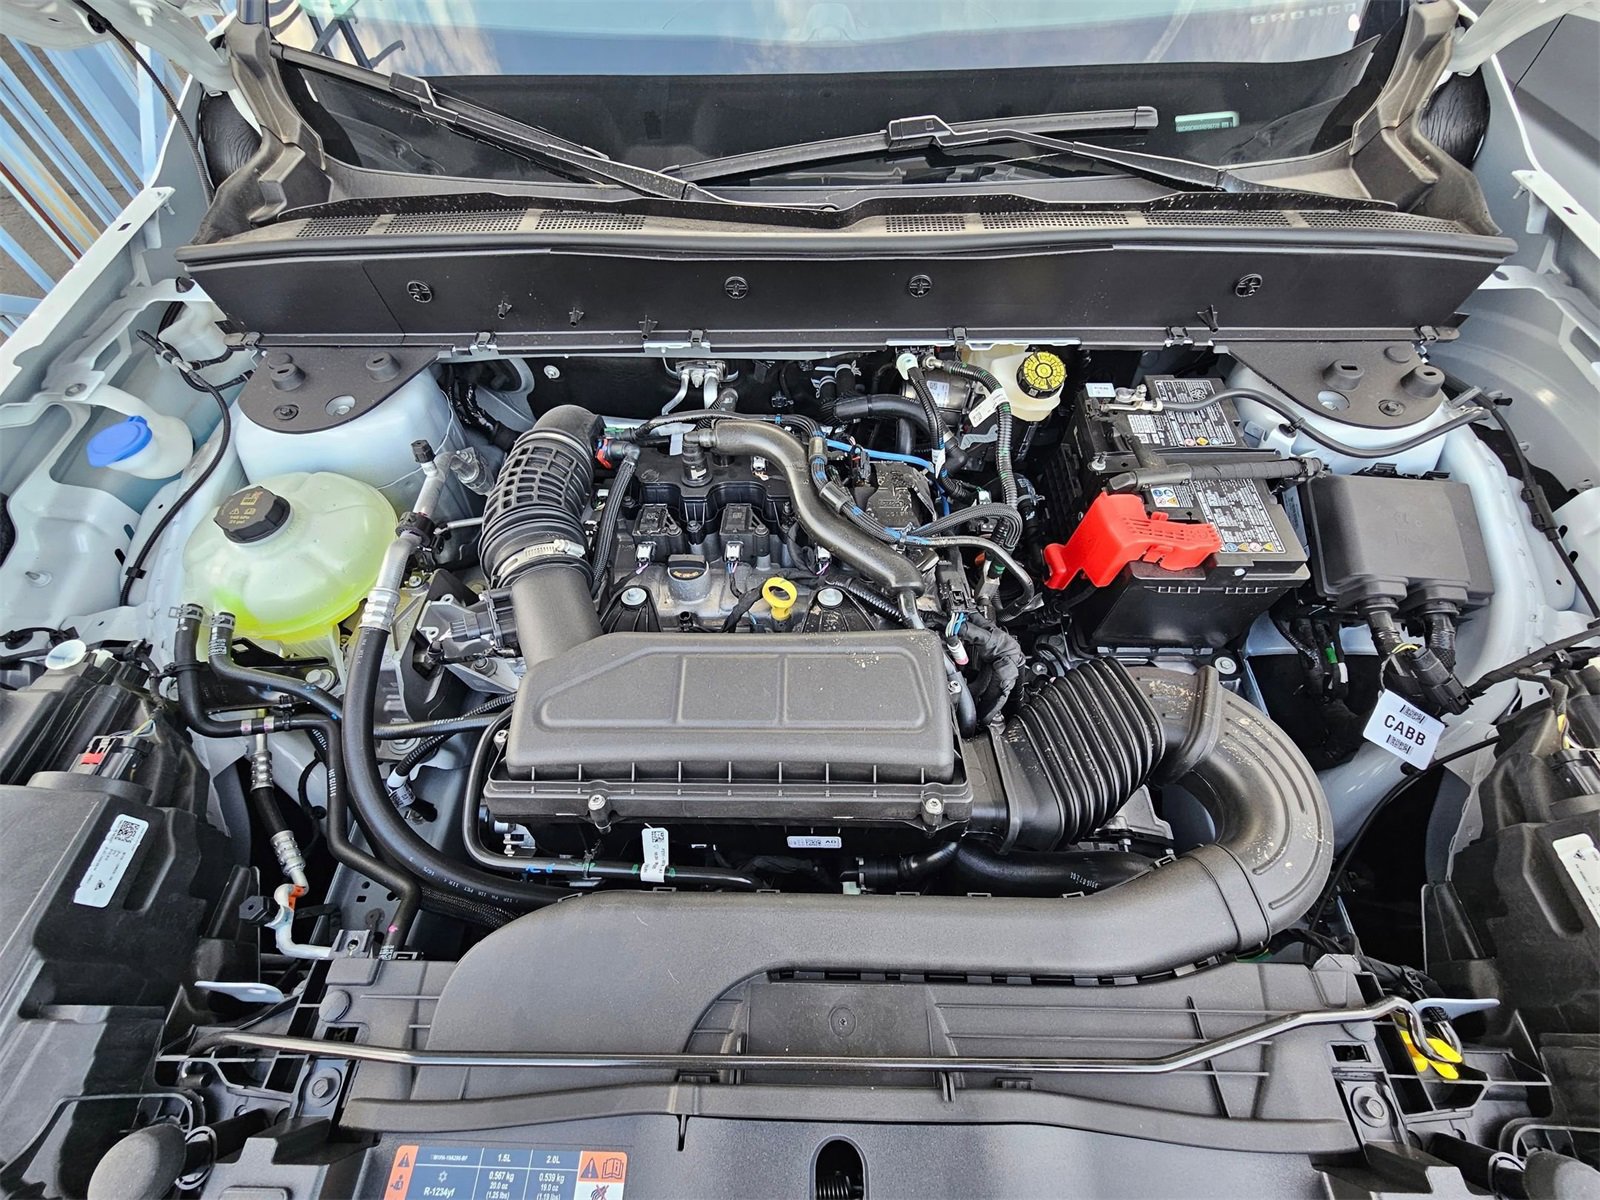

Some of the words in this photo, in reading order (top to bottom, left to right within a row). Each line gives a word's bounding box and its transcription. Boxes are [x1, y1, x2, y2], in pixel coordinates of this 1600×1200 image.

[1384, 714, 1427, 746] CABB
[497, 1153, 512, 1162] 1.5L
[546, 1155, 561, 1164] 2.0L
[488, 1170, 506, 1181] 0.567
[505, 1171, 515, 1183] kg
[538, 1172, 556, 1182] 0.539
[556, 1173, 565, 1185] kg
[423, 1186, 456, 1199] R-1234yf
